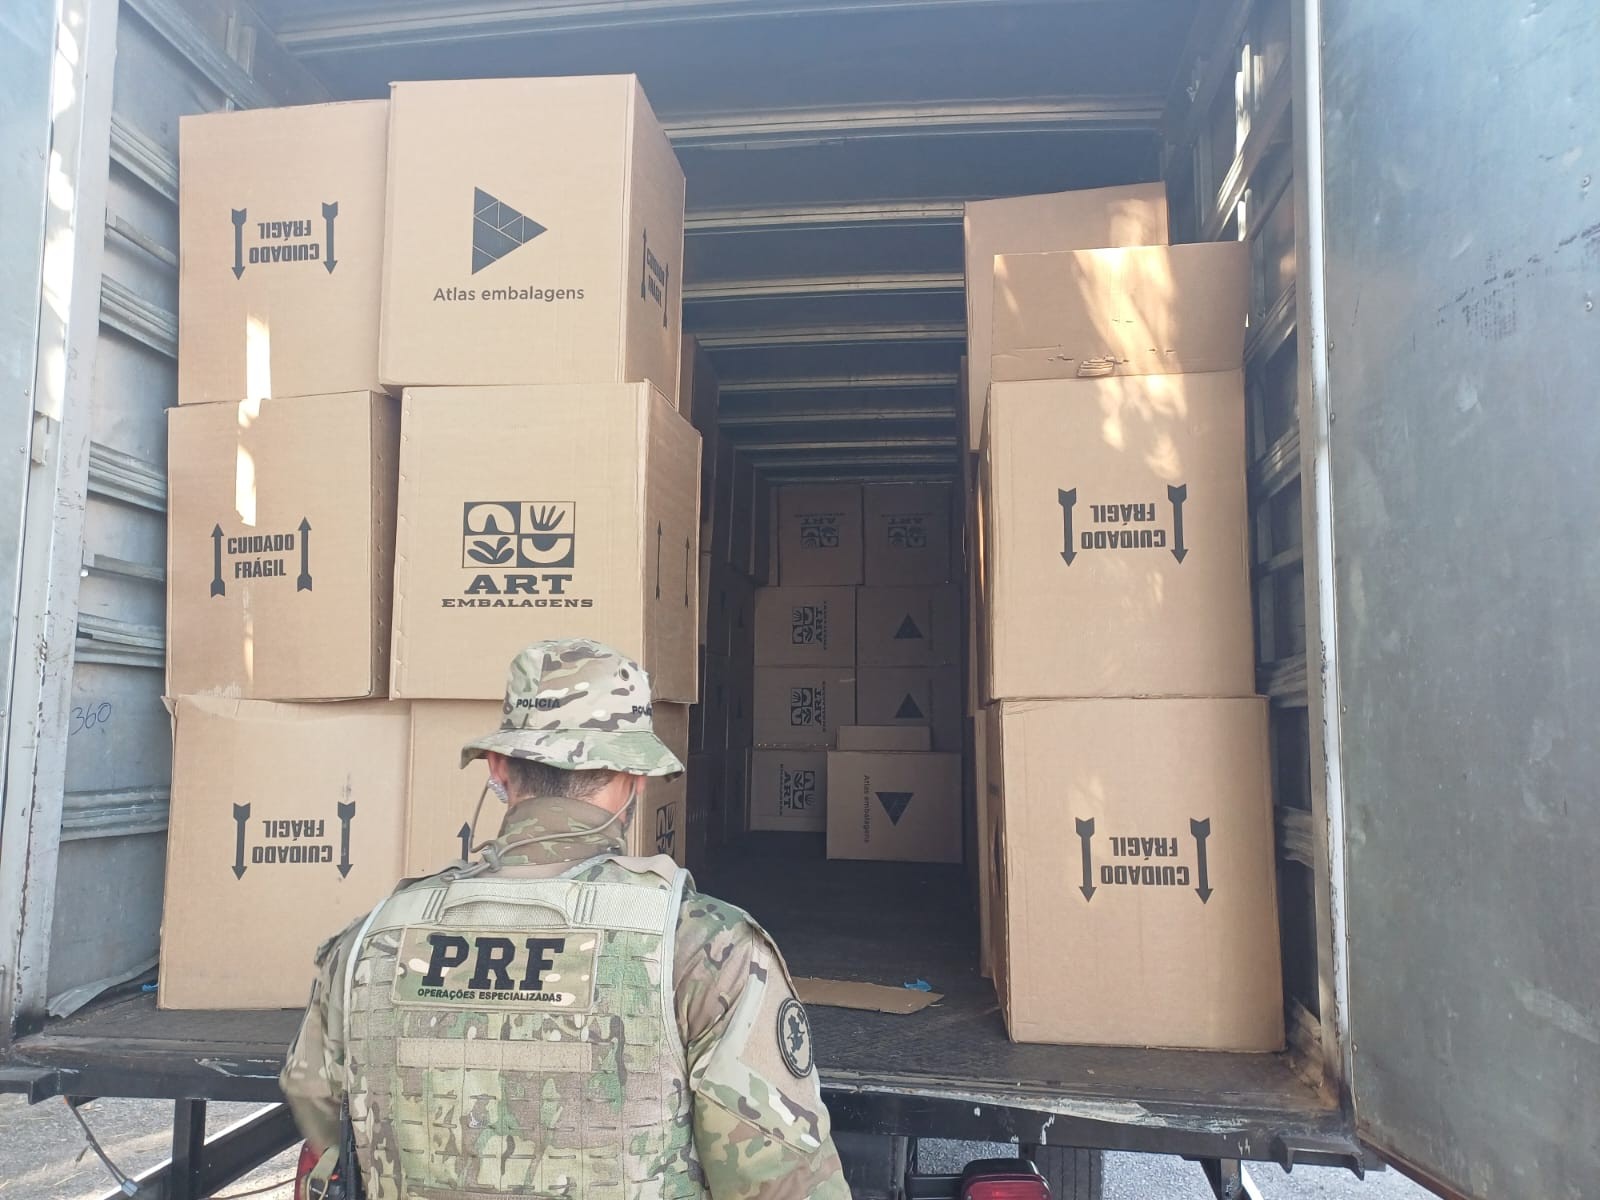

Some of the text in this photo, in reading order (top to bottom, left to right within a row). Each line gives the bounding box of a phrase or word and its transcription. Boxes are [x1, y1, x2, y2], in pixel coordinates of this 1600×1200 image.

[257, 220, 312, 242] FRÁGIL
[249, 243, 320, 264] CUIDADO
[433, 285, 585, 303] Atlas embalagens
[1090, 502, 1156, 526] FRÁGIL
[227, 533, 295, 555] CUIDADO
[1081, 529, 1167, 550] CUIDADO
[234, 556, 287, 580] FRÁGIL
[463, 573, 573, 595] ART
[441, 598, 594, 608] EMBALAGENS
[815, 607, 823, 642] ART
[71, 702, 112, 736] 360
[863, 775, 871, 795] Atlas
[262, 819, 325, 842] FRÁGIL
[251, 844, 333, 864] CUIDADO
[1109, 836, 1179, 861] FRÁGIL
[1100, 865, 1190, 886] CUIDADO
[421, 934, 565, 991] PRF
[417, 987, 562, 1003] OPERAÇÕES ESPECIALIZADAS
